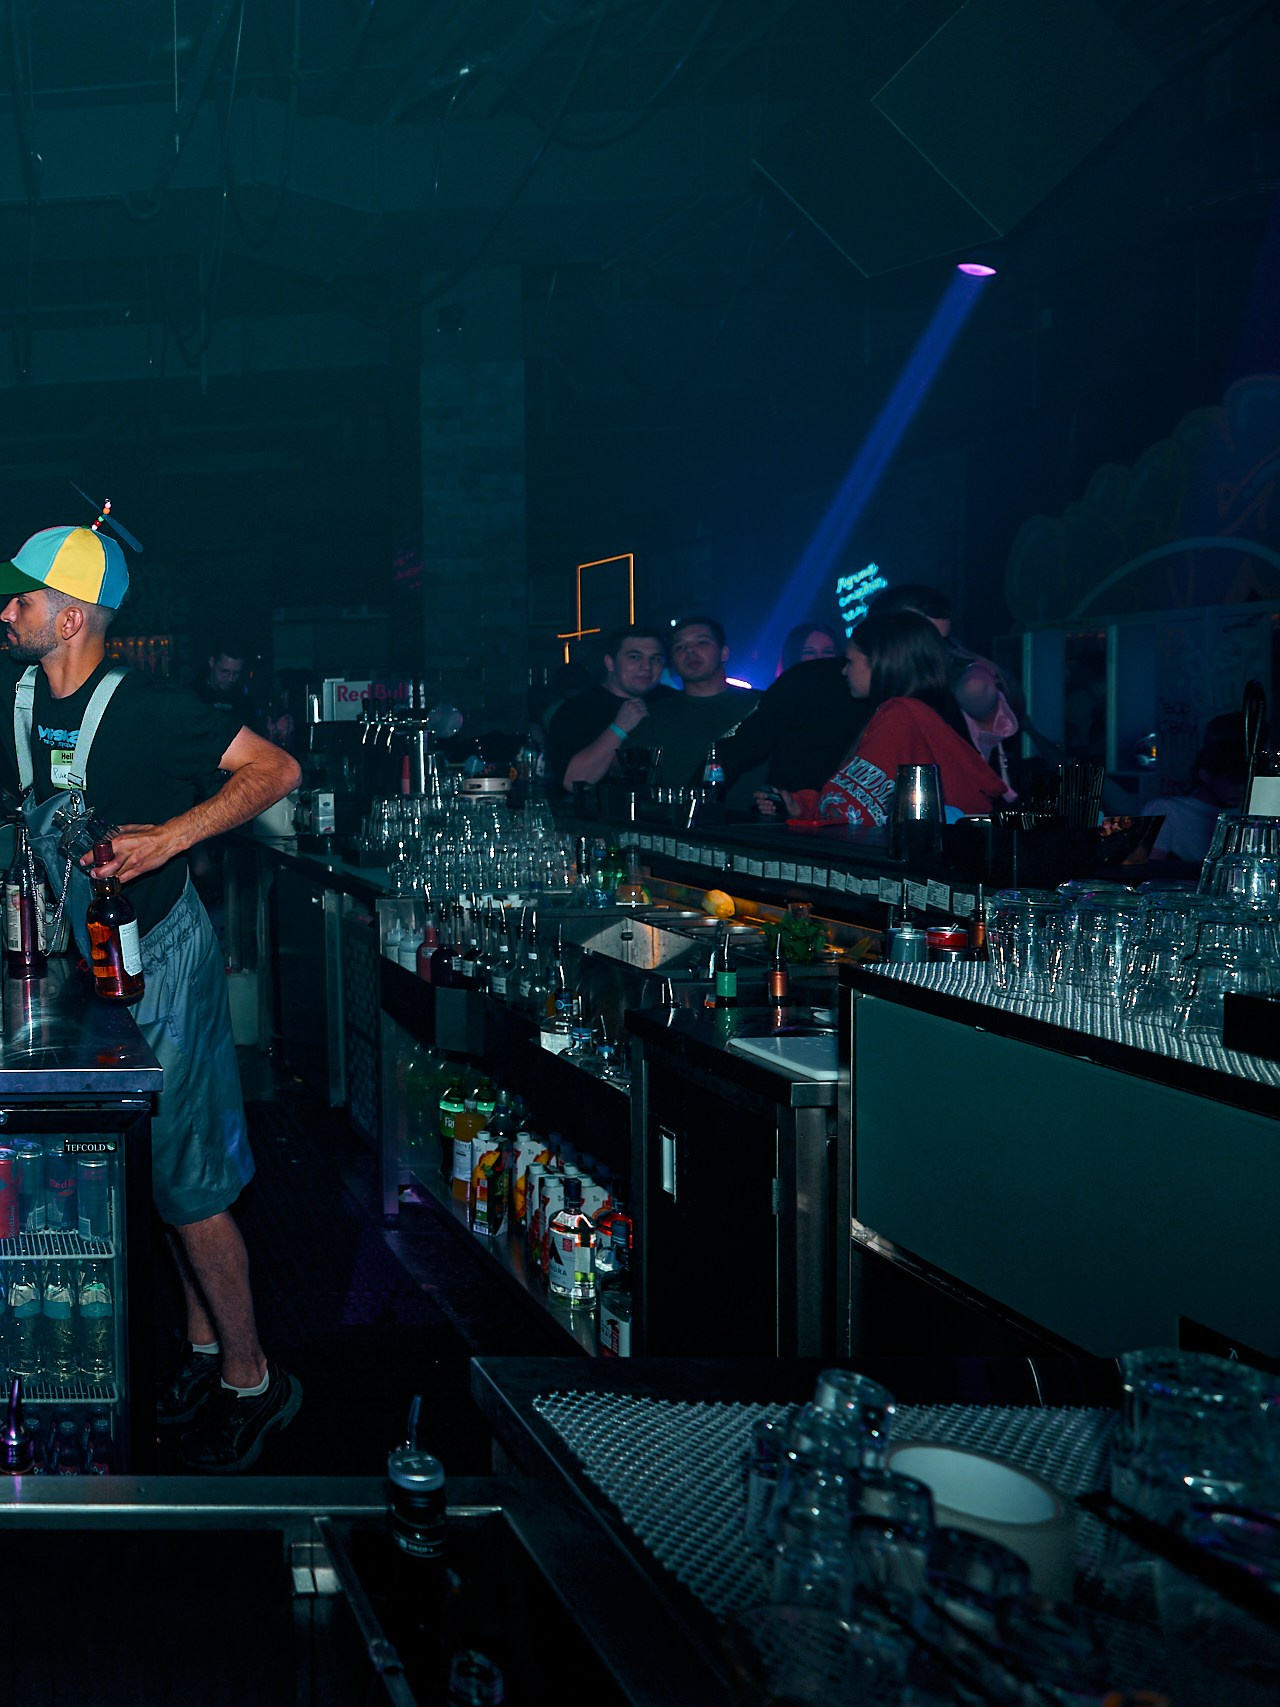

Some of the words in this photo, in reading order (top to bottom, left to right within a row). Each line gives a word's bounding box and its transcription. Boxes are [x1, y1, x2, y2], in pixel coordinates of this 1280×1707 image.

[336, 683, 371, 702] Red
[373, 679, 410, 701] Bull
[61, 752, 74, 760] Hell
[65, 1142, 106, 1152] TEFCOLD
